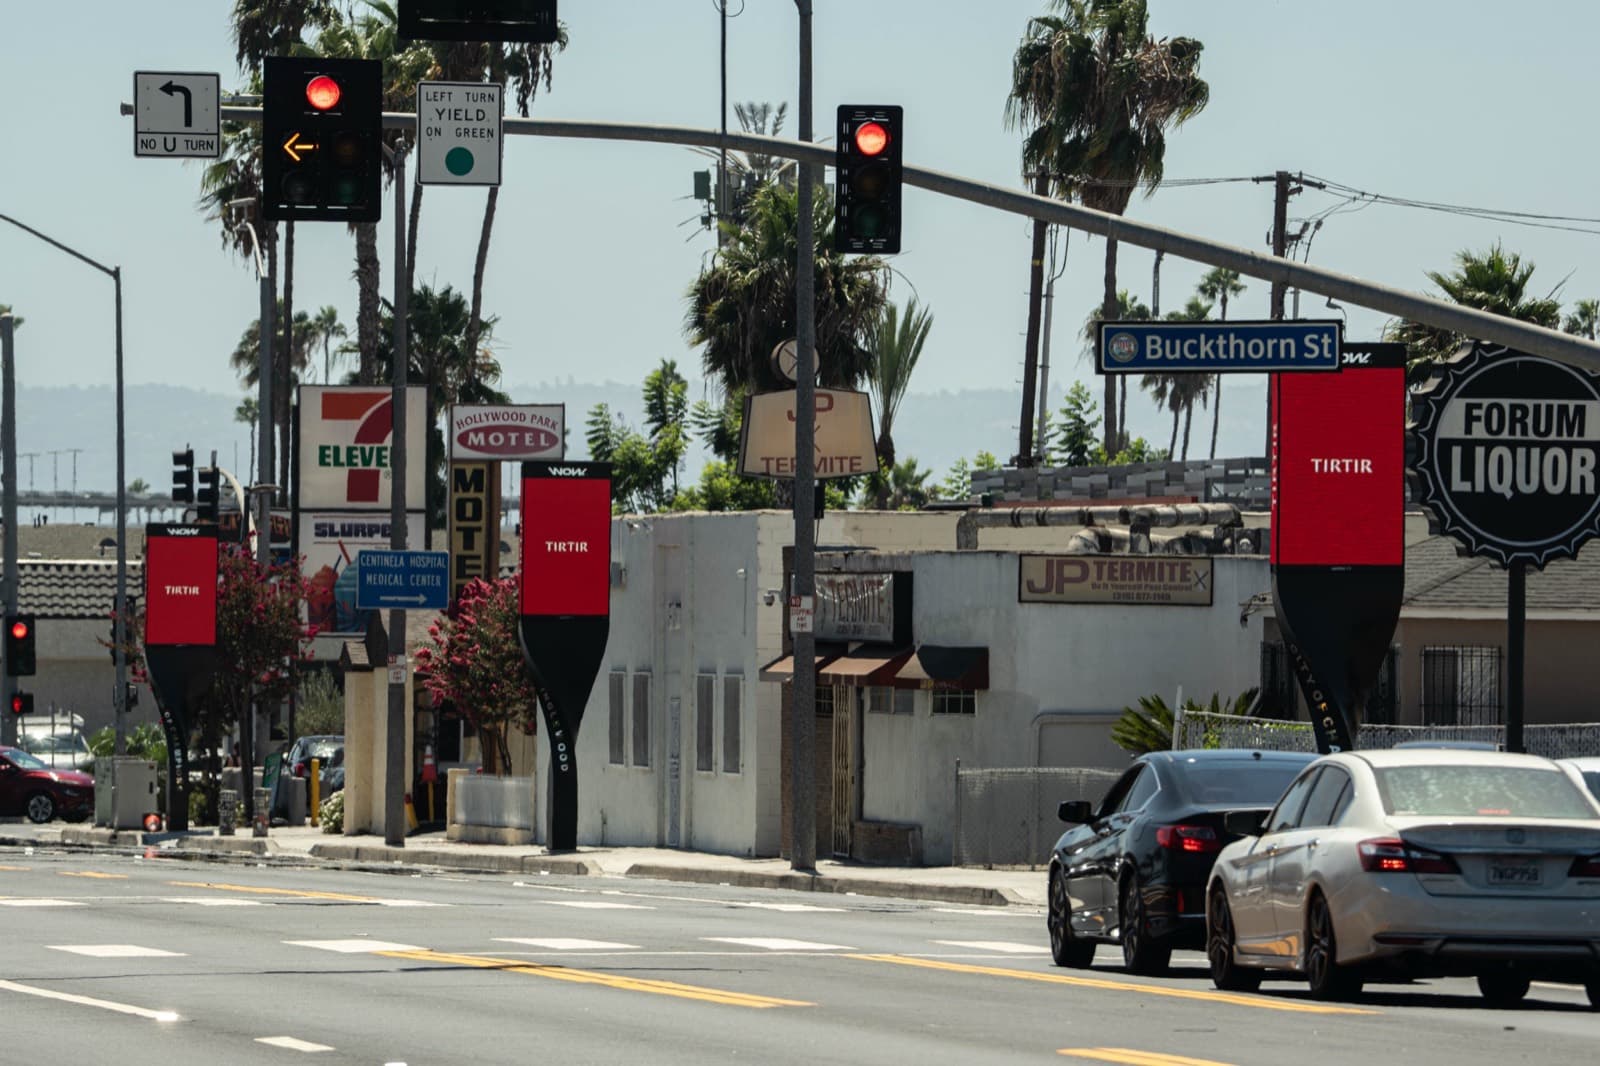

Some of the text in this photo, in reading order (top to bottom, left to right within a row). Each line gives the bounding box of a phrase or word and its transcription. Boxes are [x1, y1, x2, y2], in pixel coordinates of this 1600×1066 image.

[426, 92, 495, 103] LEFT TURN
[435, 108, 486, 121] YIELD
[426, 126, 494, 138] ON GREEN
[140, 136, 214, 153] NO U TURN
[1145, 333, 1296, 360] Buckthorn
[1303, 332, 1333, 359] St
[456, 411, 559, 432] HOLLYWOOD PARK
[1464, 402, 1587, 438] FORUM
[321, 391, 393, 502] 7
[467, 432, 550, 447] MOTEL
[318, 445, 392, 468] ELEVE
[548, 466, 588, 477] WOW
[1311, 458, 1373, 474] TIRTIR
[1451, 445, 1597, 501] LIQUOR
[167, 527, 200, 536] WOW
[314, 522, 405, 538] SLURPE
[545, 541, 589, 552] TIRTIR
[360, 554, 447, 569] CENTINELA HOSPITAL
[366, 573, 442, 587] MEDICAL CENTER
[1026, 559, 1192, 594] JP TERMITE
[165, 586, 199, 595] TIRTIR
